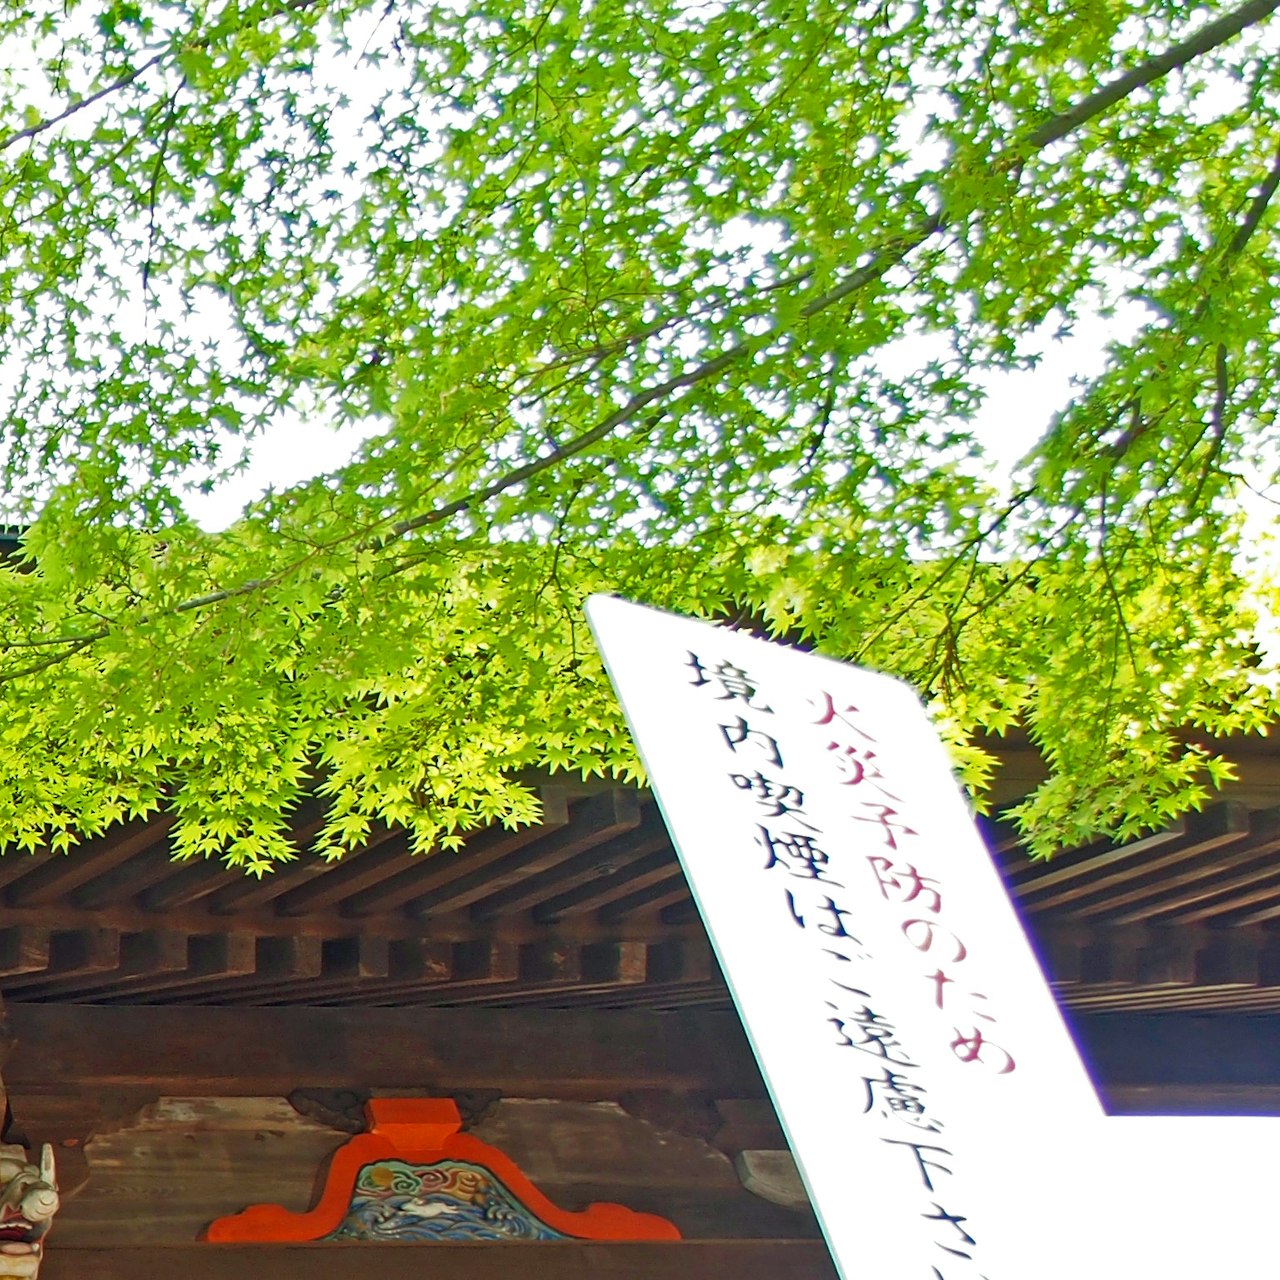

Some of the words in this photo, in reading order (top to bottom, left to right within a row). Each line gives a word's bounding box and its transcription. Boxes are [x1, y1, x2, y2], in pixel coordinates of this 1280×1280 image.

[806, 690, 1016, 1074] 火災予防のため
